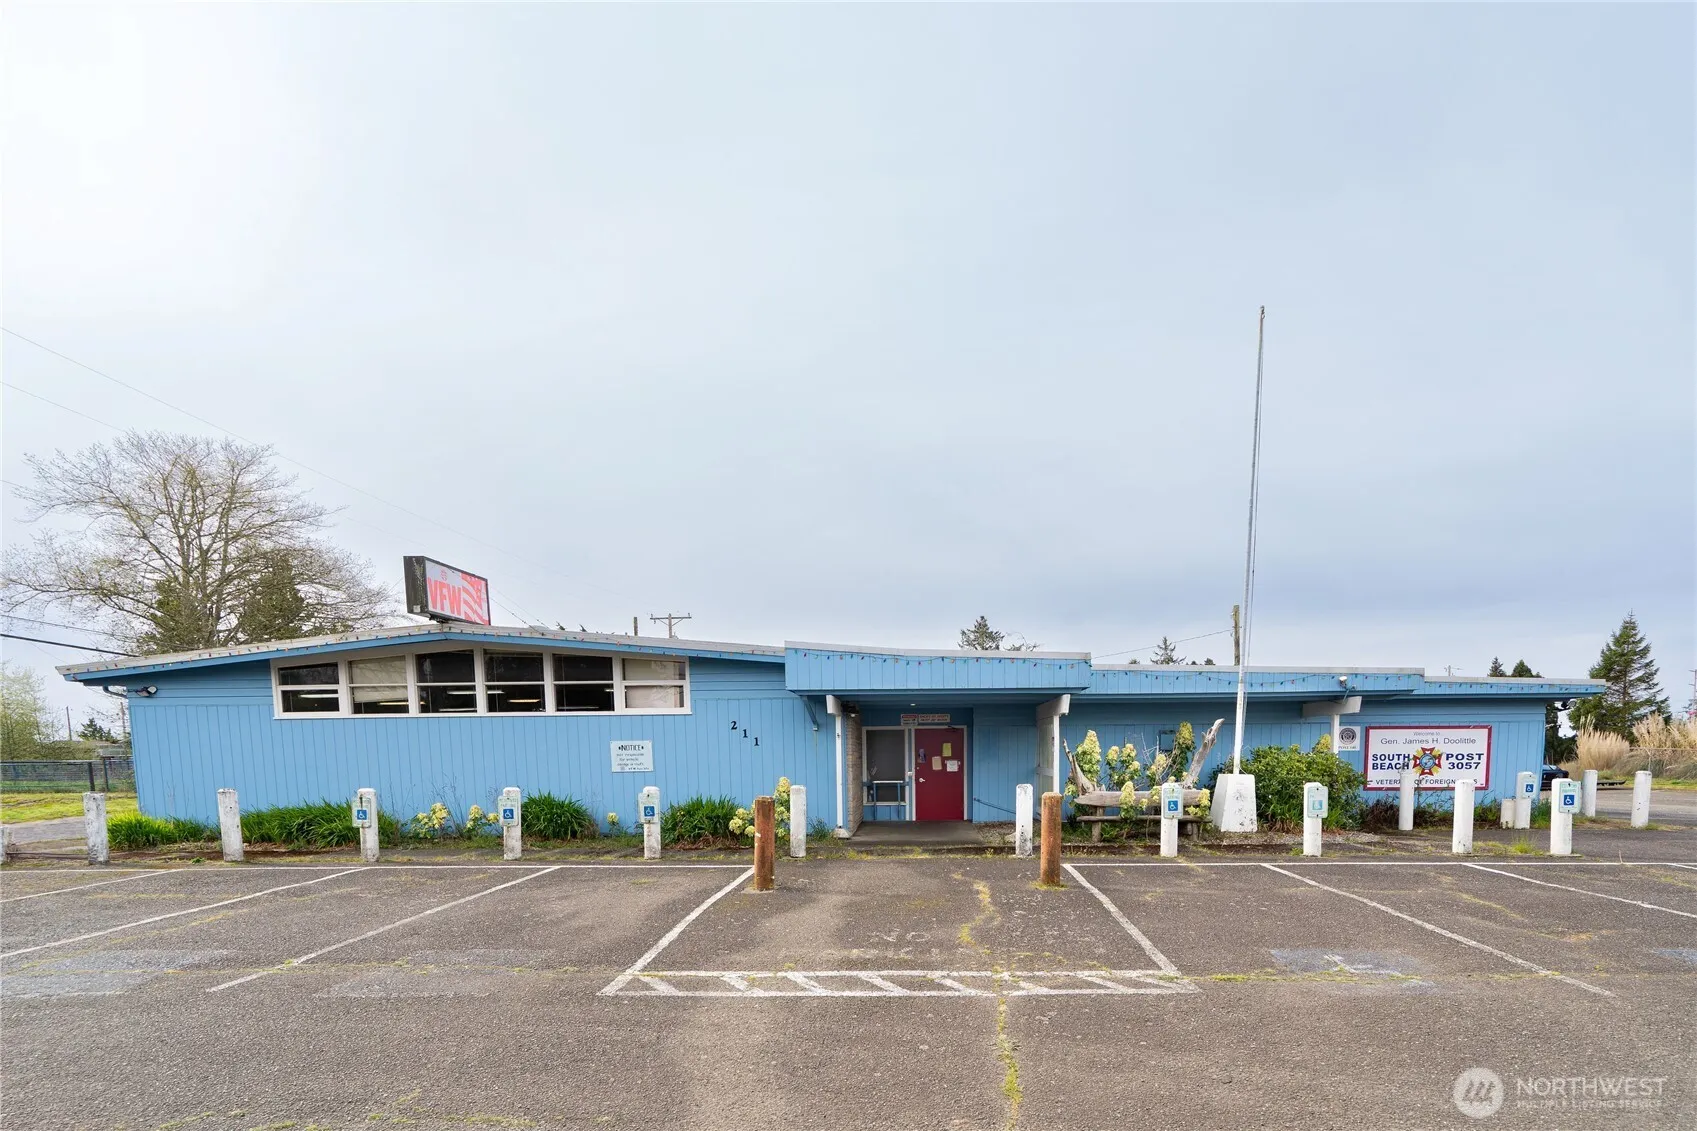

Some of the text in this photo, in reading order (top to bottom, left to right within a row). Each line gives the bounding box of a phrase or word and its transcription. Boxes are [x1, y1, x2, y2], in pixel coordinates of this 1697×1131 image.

[427, 577, 462, 616] VFW
[1380, 737, 1476, 745] Gen. James H. Doolittle
[1371, 753, 1411, 762] SOUTH
[1445, 752, 1484, 761] POST
[1371, 762, 1410, 771] BEACH
[1447, 761, 1481, 770] 3057
